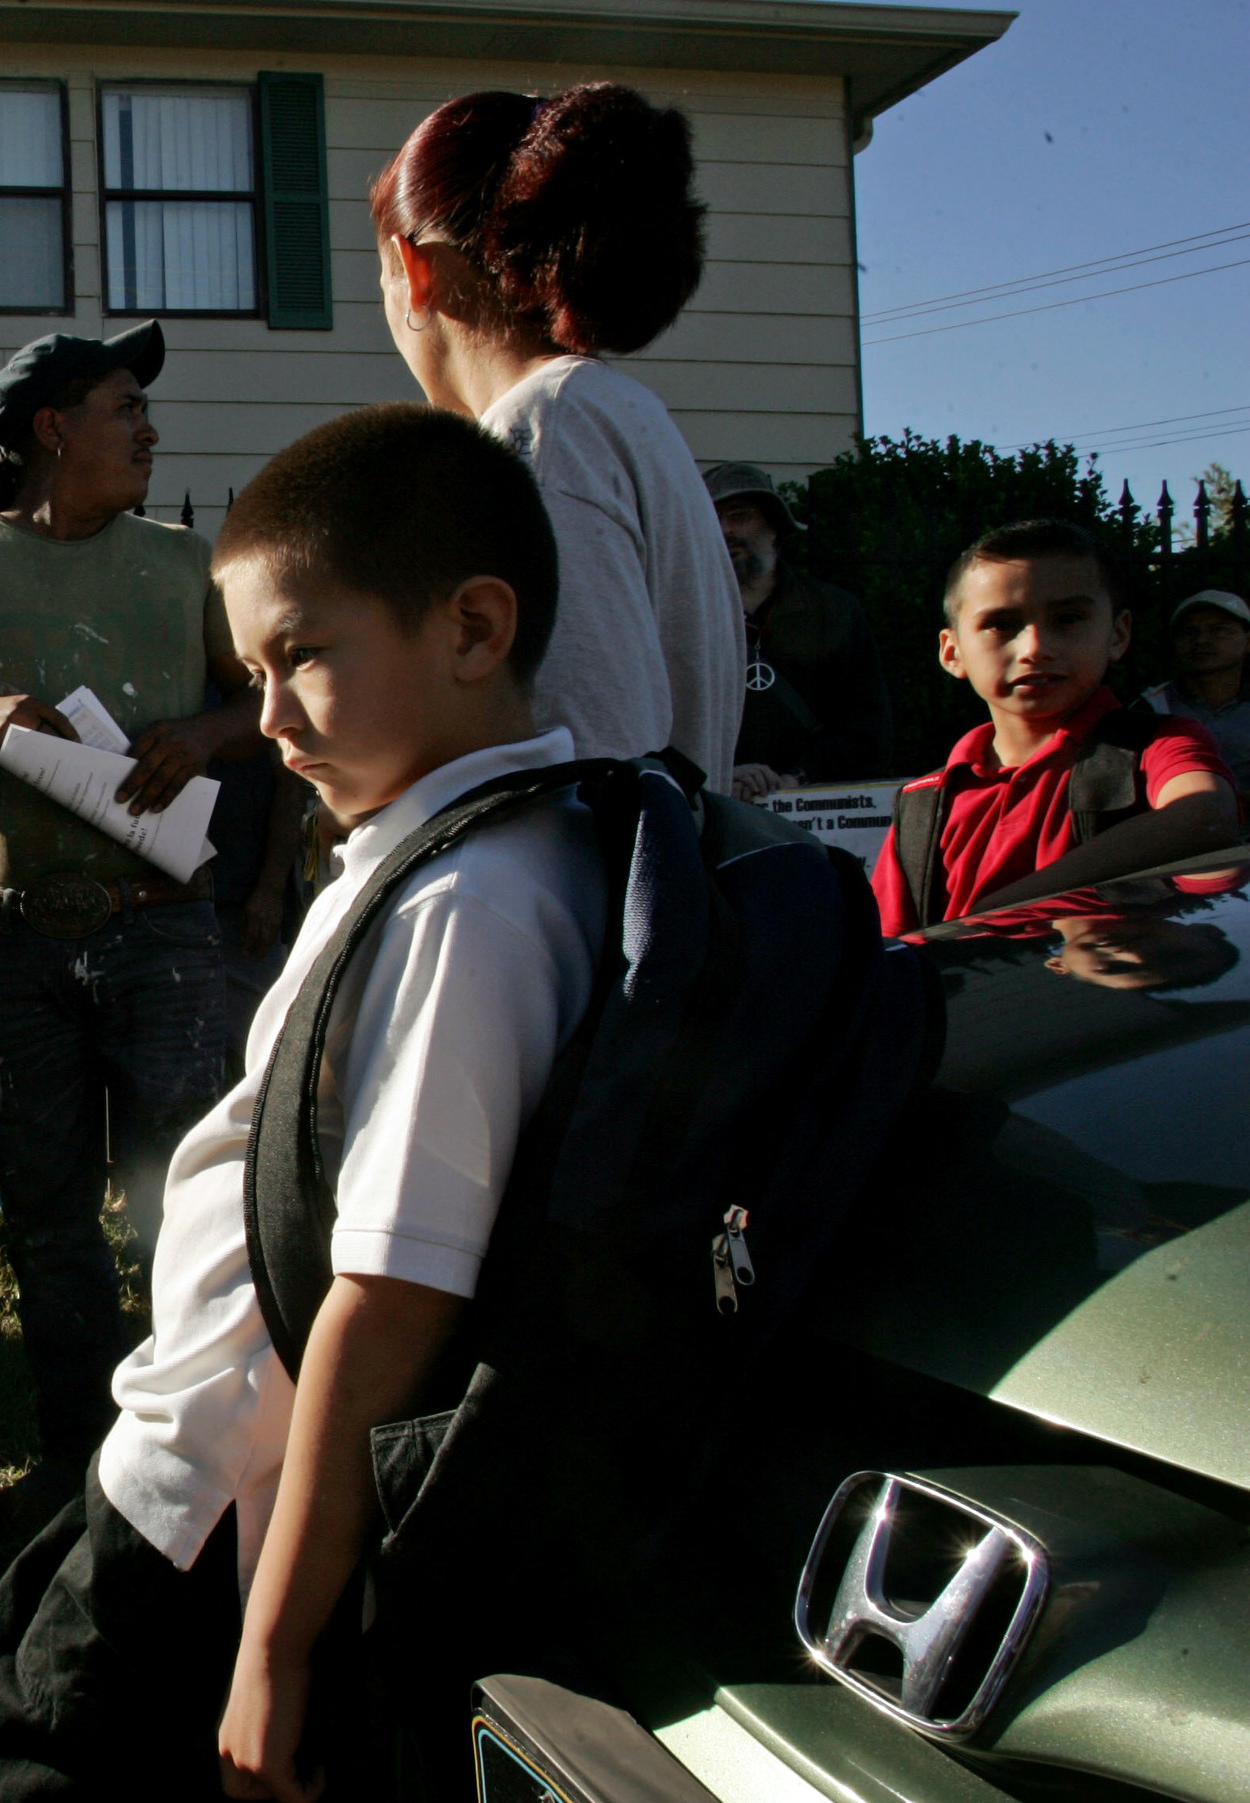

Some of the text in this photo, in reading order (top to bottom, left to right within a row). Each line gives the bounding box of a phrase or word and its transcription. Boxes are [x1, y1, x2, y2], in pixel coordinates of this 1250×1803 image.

[772, 799, 793, 813] the
[795, 795, 877, 812] Communists,
[826, 818, 835, 830] a
[837, 815, 893, 829] Commun
